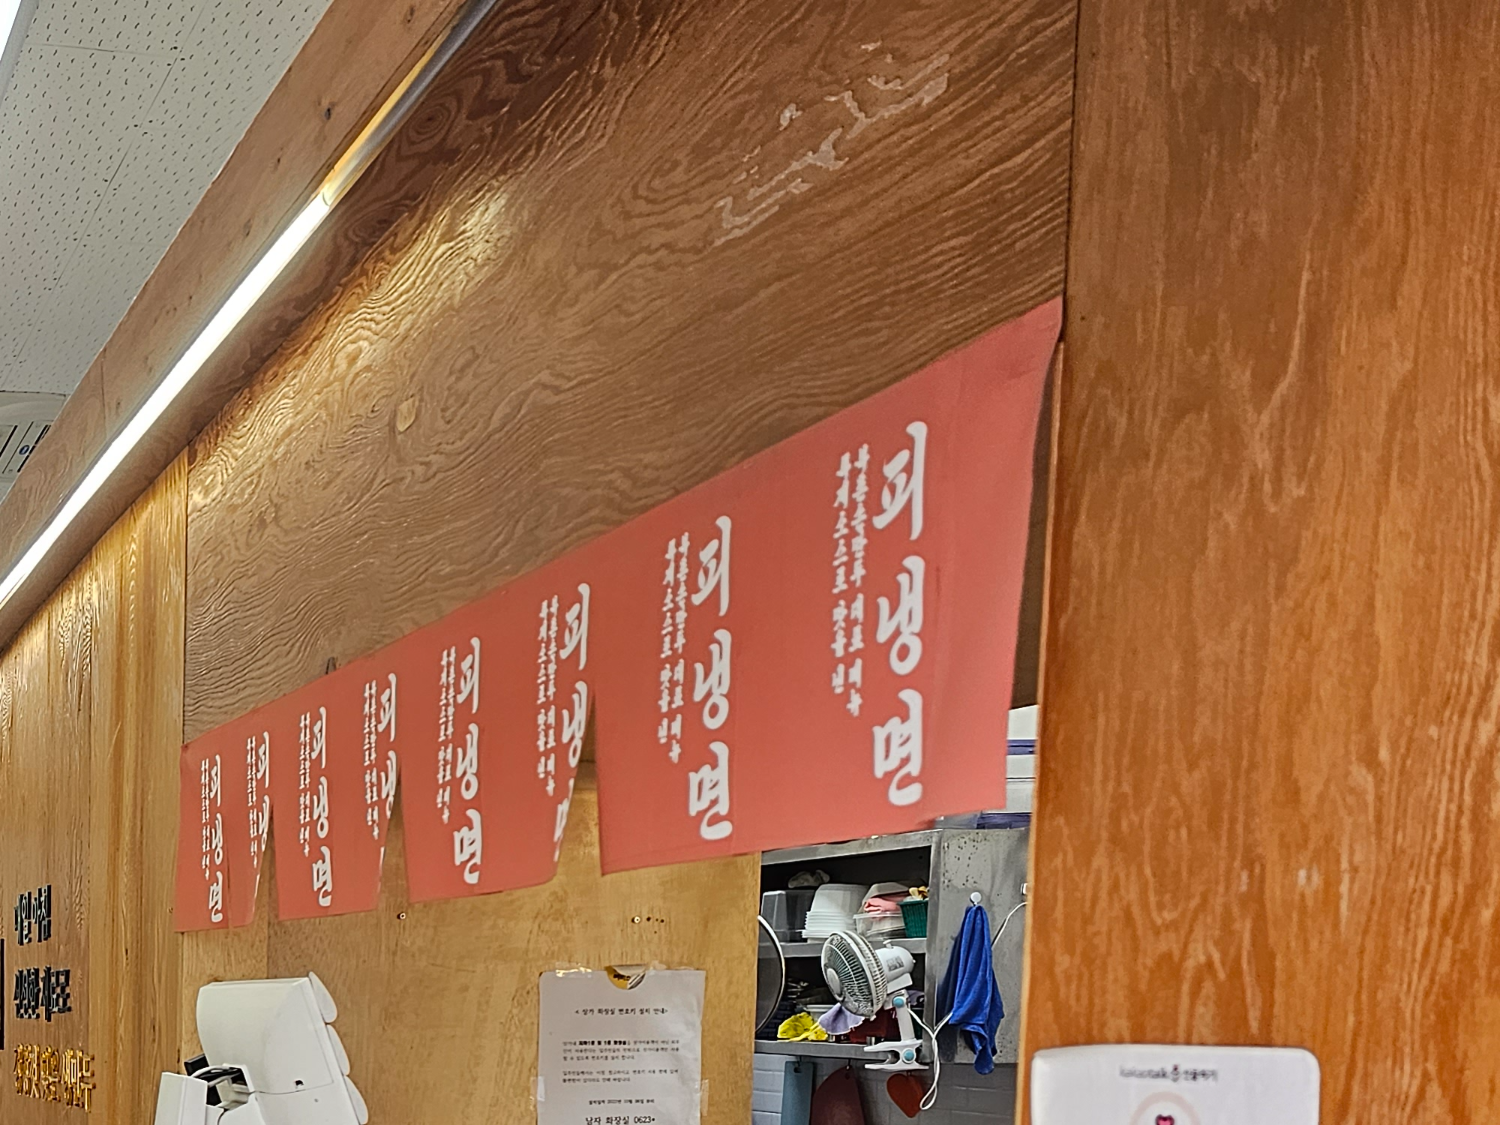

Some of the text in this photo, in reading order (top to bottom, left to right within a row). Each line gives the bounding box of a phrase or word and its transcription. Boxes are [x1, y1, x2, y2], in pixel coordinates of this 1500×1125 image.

[688, 515, 732, 840] 피냉면
[872, 421, 928, 806] 피냉면
[209, 754, 223, 923] 피냉면
[253, 731, 270, 914] 피냉
[310, 706, 332, 907] 피냉면
[377, 673, 397, 893] 피냉
[453, 636, 482, 884] 피냉면
[13, 965, 72, 1022] 신선한 재료로
[14, 891, 32, 946] 매일
[32, 884, 51, 943] 아침
[597, 1008, 616, 1016] 화장실
[585, 1116, 601, 1125] 남자
[605, 1116, 630, 1125] 화장실
